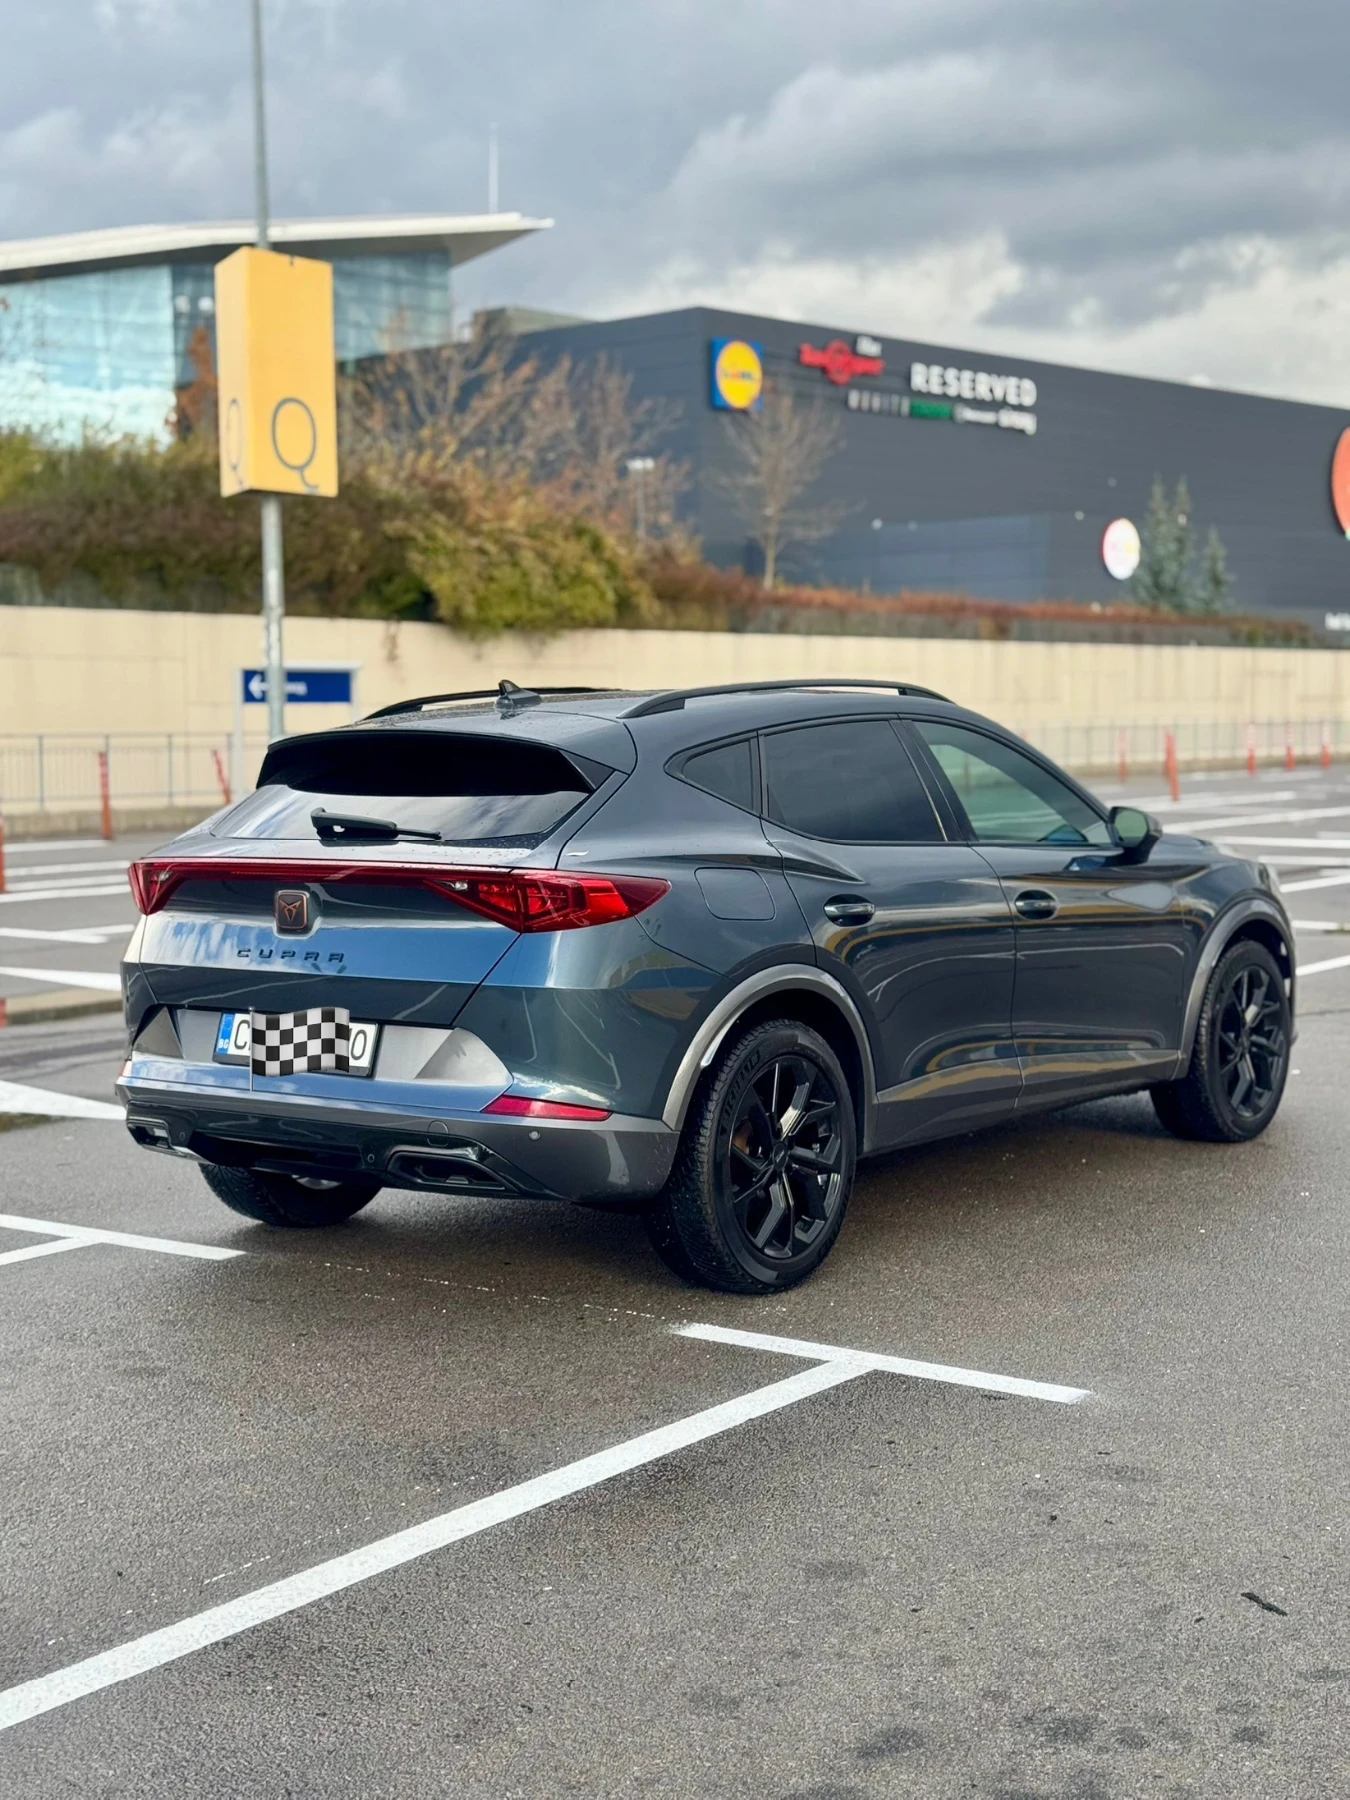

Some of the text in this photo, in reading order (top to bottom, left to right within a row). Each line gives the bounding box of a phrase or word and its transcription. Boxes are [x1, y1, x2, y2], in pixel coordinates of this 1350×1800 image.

[910, 361, 1037, 407] RESERVED
[271, 397, 318, 490] Q
[236, 948, 345, 963] CUPRA
[218, 1038, 230, 1050] BG
[234, 1019, 251, 1051] C
